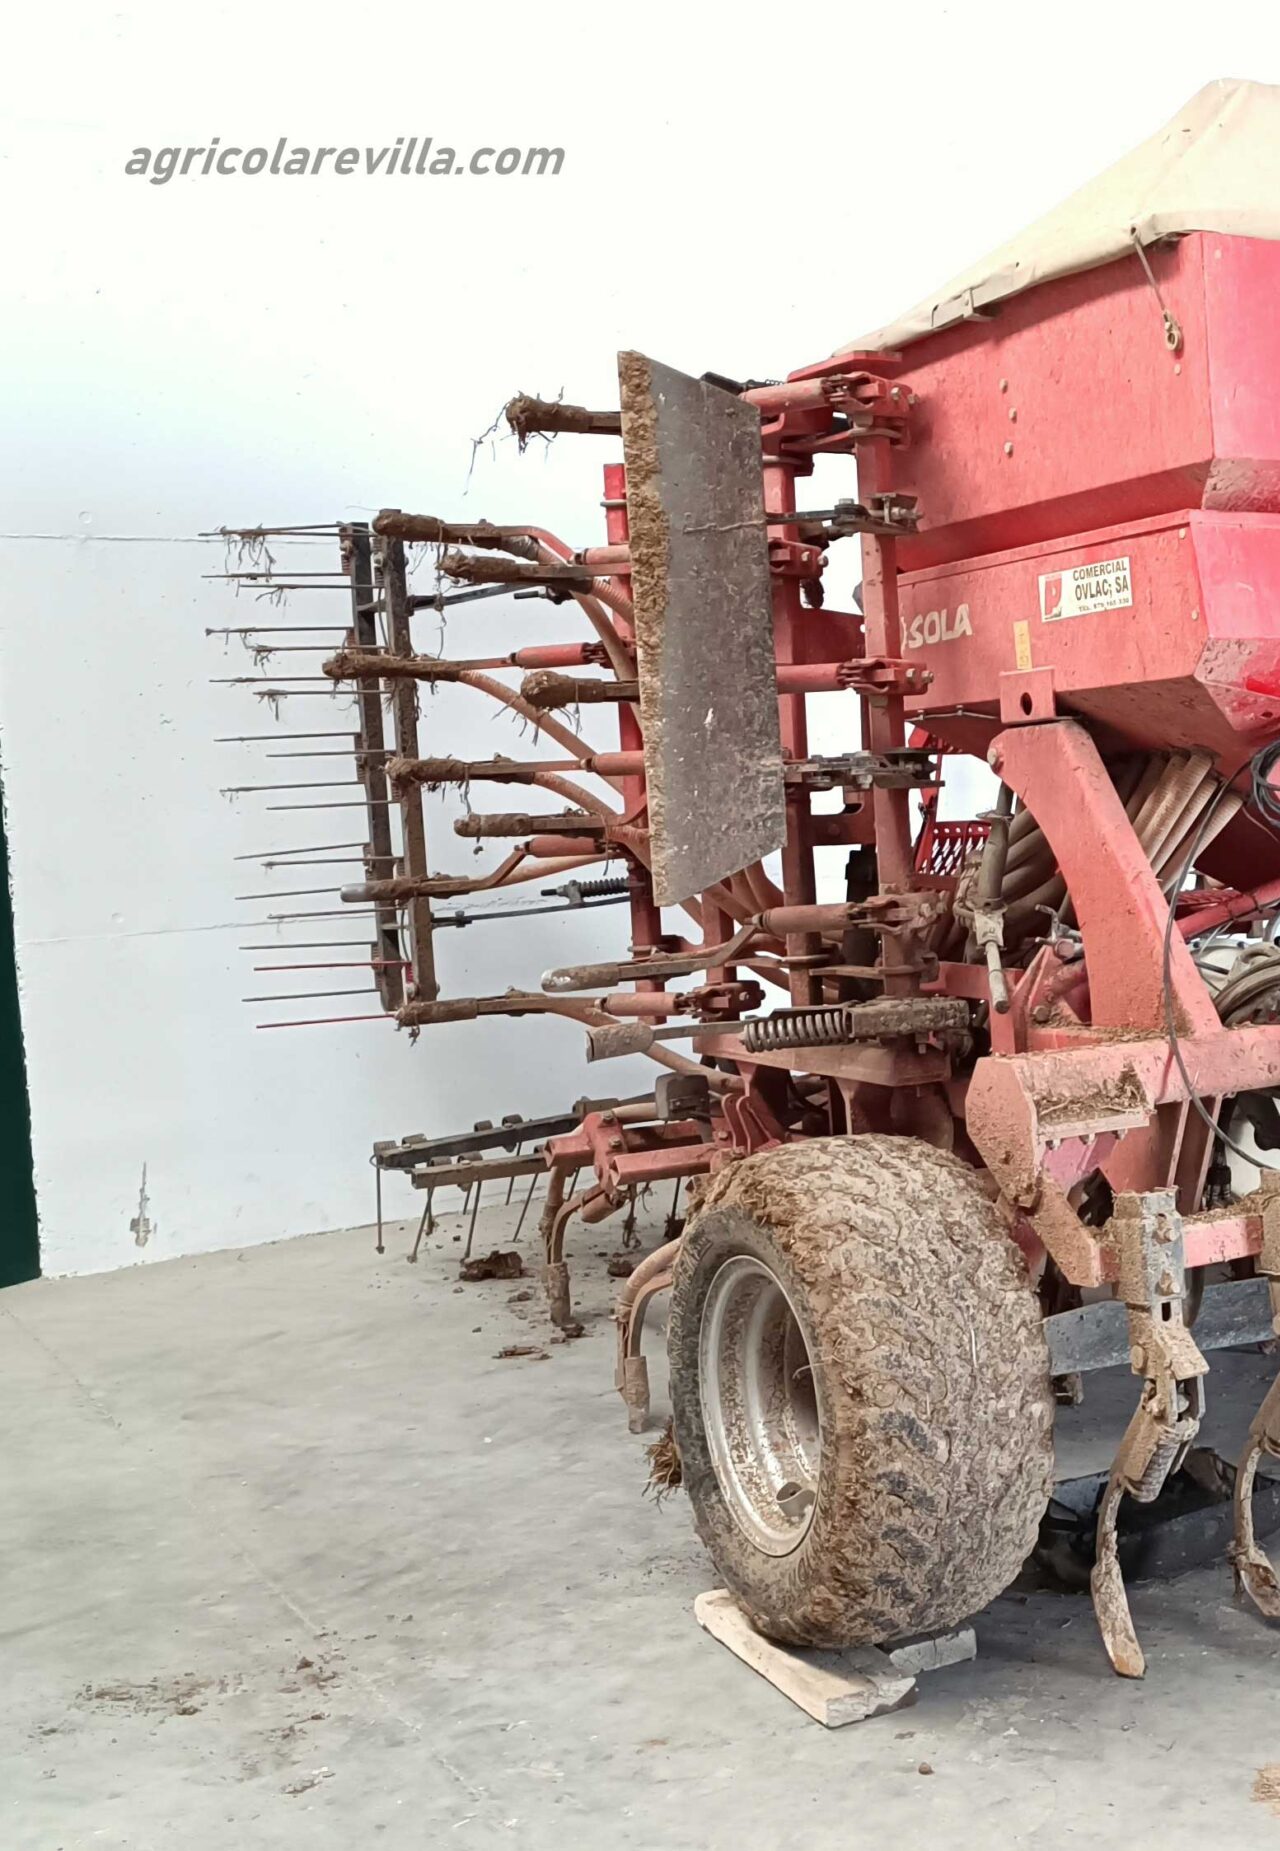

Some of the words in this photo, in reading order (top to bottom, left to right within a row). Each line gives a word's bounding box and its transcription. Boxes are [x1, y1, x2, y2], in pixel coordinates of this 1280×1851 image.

[1073, 560, 1127, 581] COMERCIAL
[1115, 575, 1129, 593] SA
[908, 603, 973, 649] SOLA
